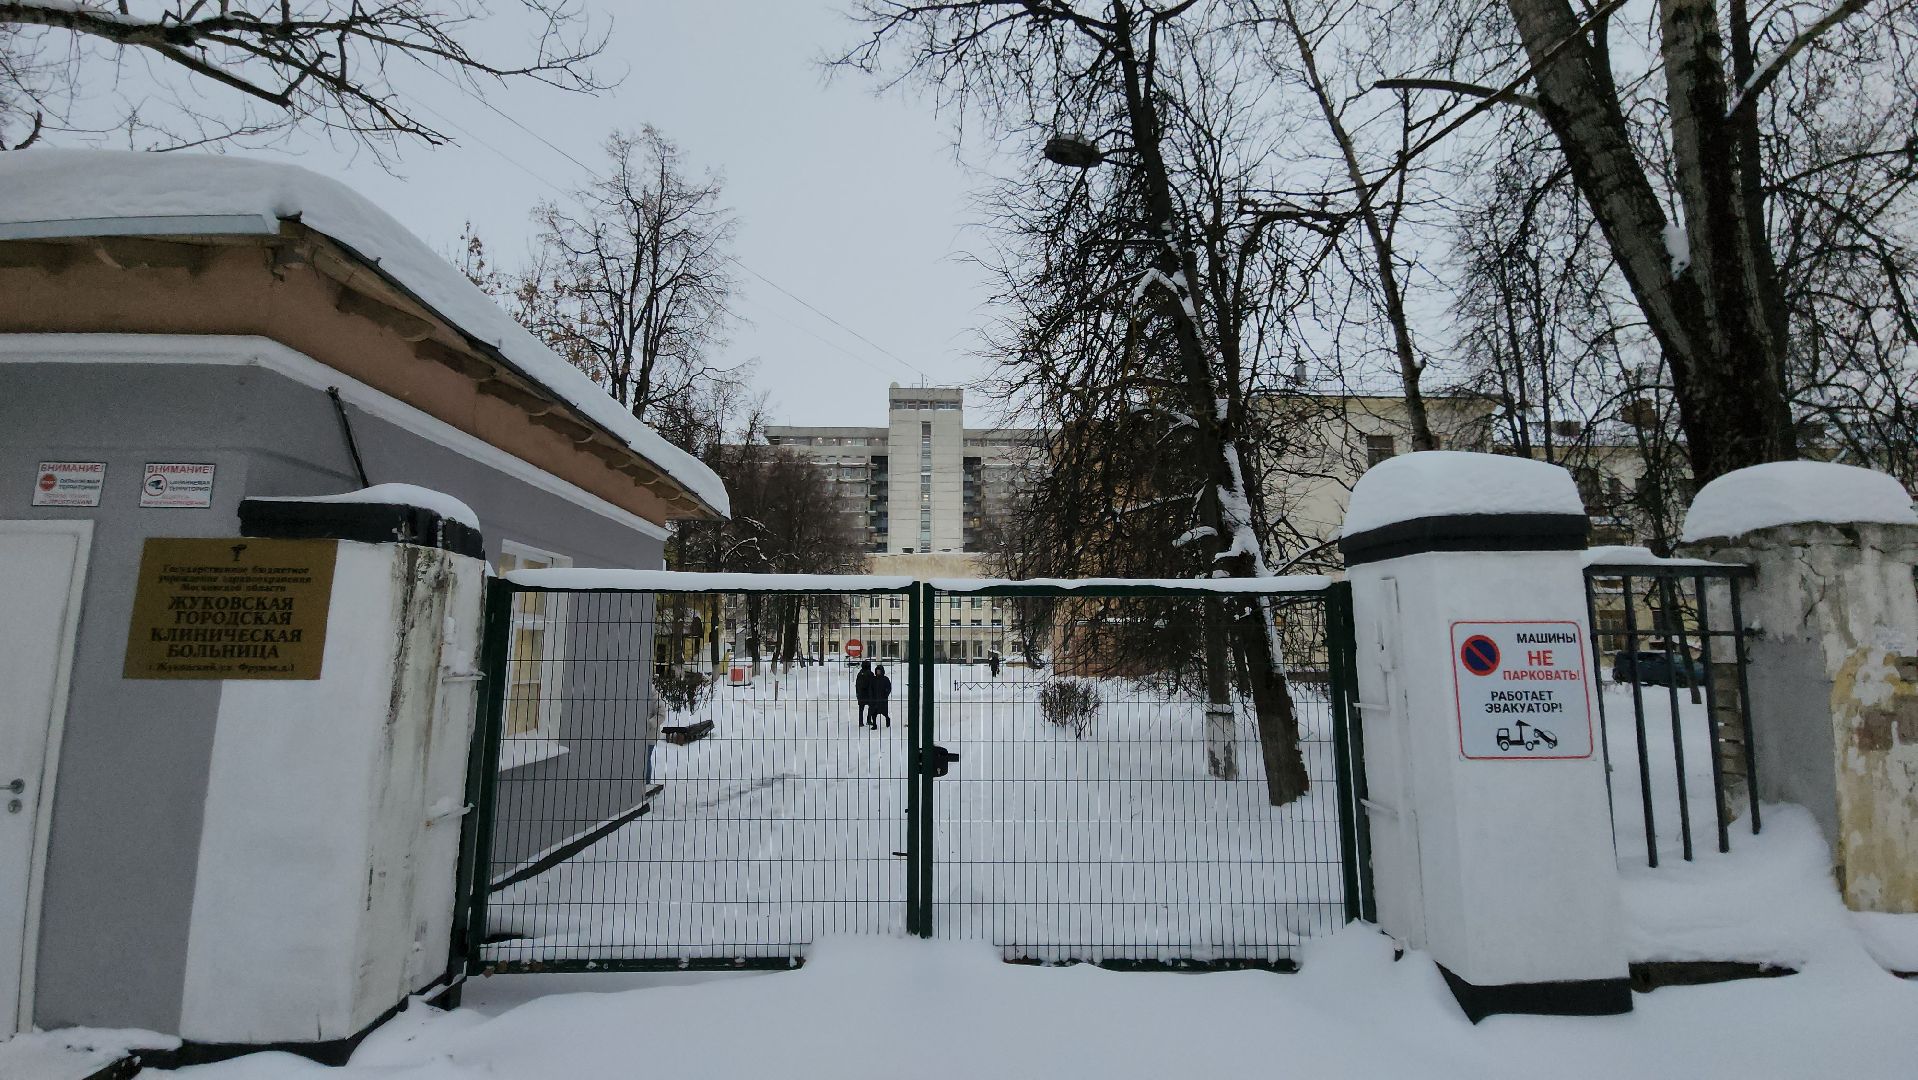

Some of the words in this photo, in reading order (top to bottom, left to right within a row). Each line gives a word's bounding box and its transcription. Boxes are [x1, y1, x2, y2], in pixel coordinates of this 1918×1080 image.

[168, 596, 293, 610] ЖУКОВСКАЯ
[175, 611, 292, 625] ГОРОДСКАЯ
[151, 628, 303, 643] КЛИНИЧЕСКАЯ
[1516, 632, 1577, 644] МАШИНЫ
[166, 645, 280, 660] БОЛЬНИЦА
[1527, 650, 1555, 667] НЕ
[1502, 670, 1581, 681] ПАРКОВАТЬ!
[1490, 690, 1554, 701] РАБОТАЕТ
[1484, 703, 1563, 714] ЭВАКУАТОР!
